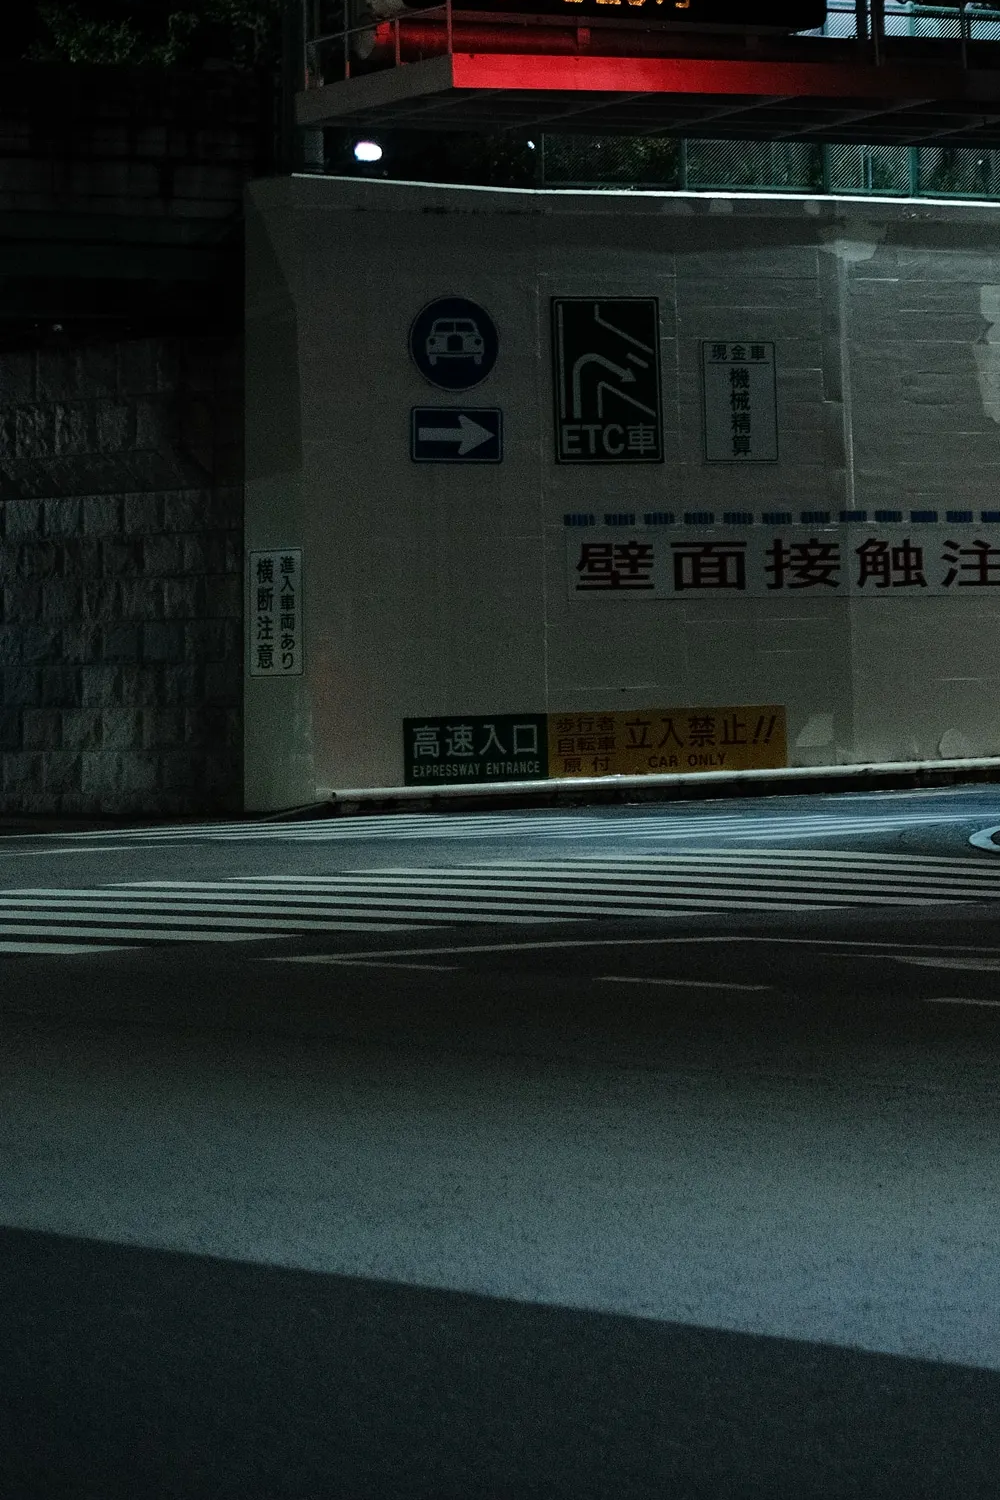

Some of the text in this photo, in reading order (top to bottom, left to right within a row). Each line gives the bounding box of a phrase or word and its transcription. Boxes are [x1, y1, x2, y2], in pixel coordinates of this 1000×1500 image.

[712, 344, 766, 360] 現金車
[729, 367, 752, 457] 機械精算
[561, 422, 658, 456] ETC車
[256, 558, 274, 669] 横断注意
[280, 556, 295, 670] 進入車両あり
[556, 716, 616, 733] 歩行者
[412, 723, 539, 760] 高速入口
[557, 737, 616, 753] 自転車
[412, 760, 541, 778] EXPRESSWAY ENTRANCE
[563, 756, 611, 773] 原付
[647, 752, 727, 768] CAR ONLY
